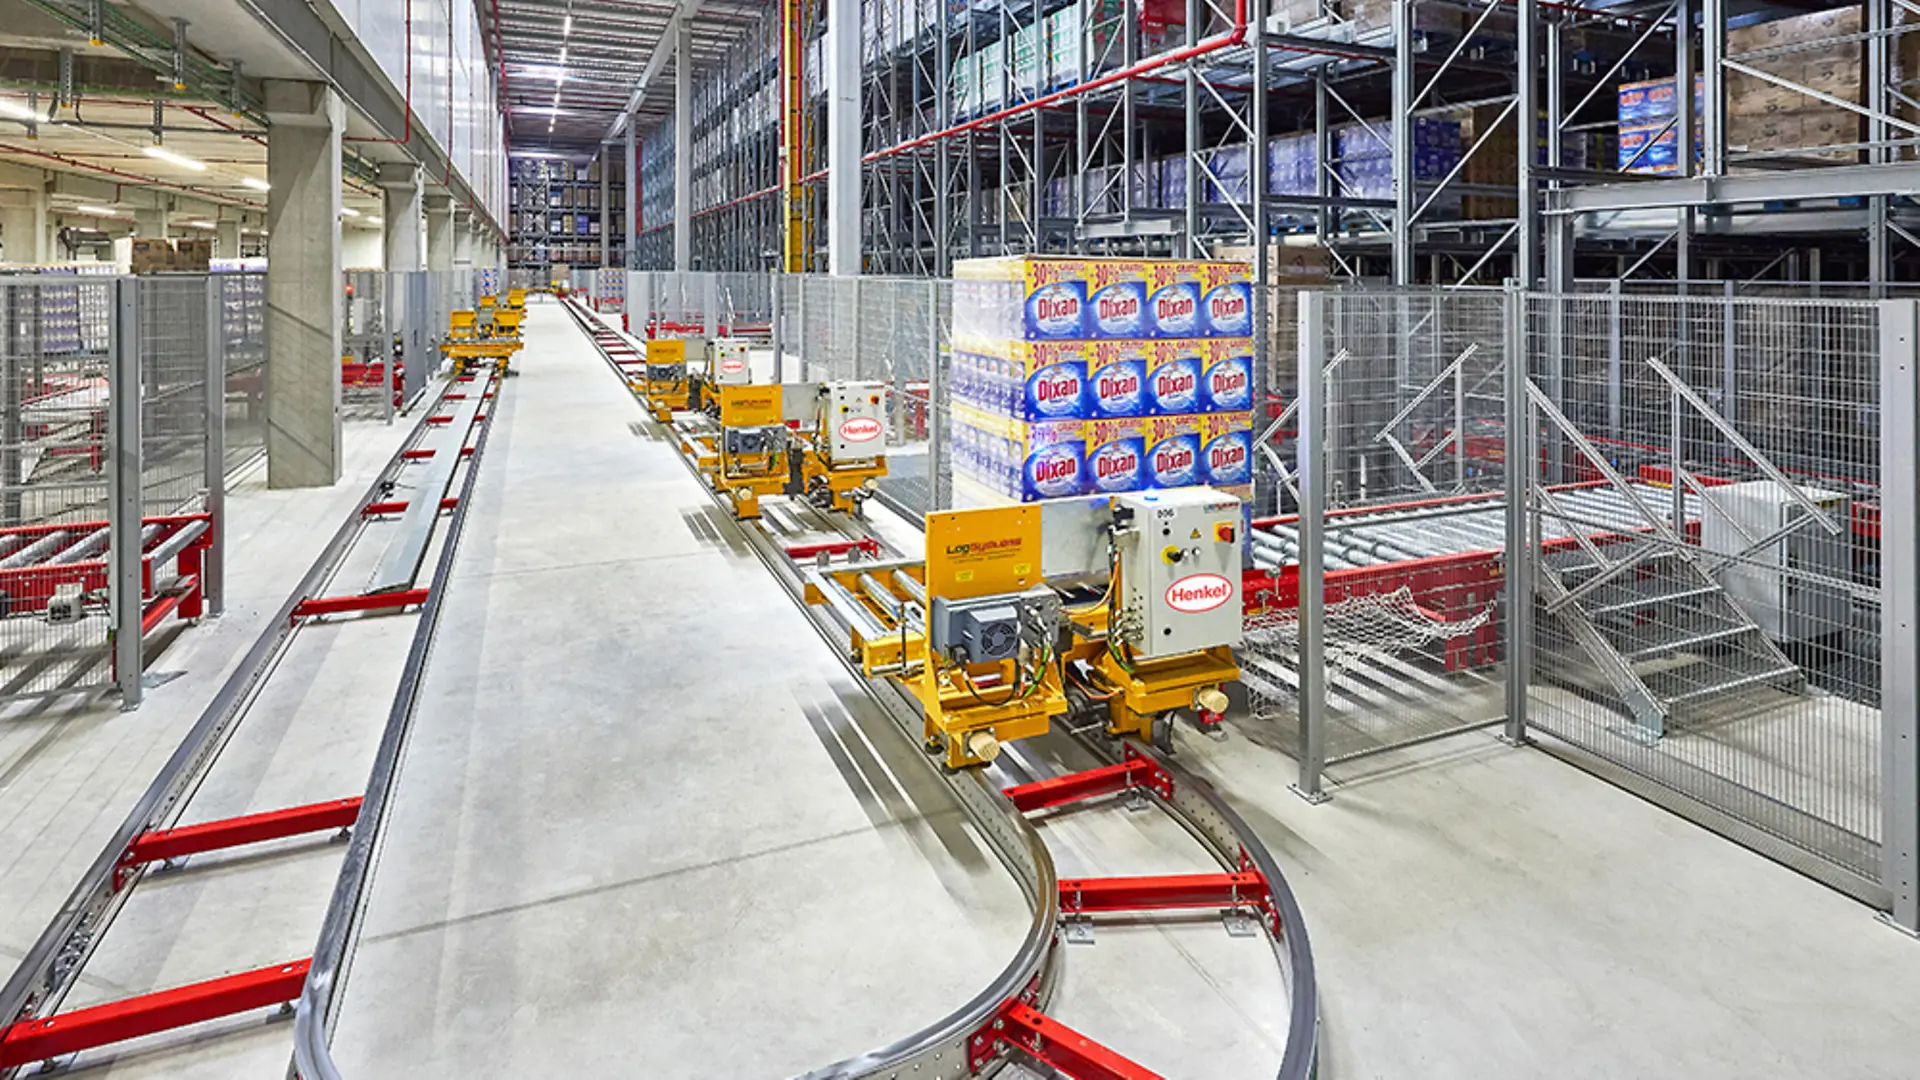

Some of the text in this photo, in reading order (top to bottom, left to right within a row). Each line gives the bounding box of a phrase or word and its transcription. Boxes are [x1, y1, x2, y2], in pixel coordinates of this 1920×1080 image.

[1038, 298, 1078, 320] Dixan
[1100, 298, 1137, 319] Dixan
[1158, 298, 1193, 319] Dixan
[1212, 298, 1244, 318] Dixan
[1038, 378, 1078, 401] Dixan
[1100, 376, 1137, 399] Dixan
[1158, 374, 1193, 397] Dixan
[1213, 372, 1245, 394] Dixan
[843, 423, 877, 435] Henkel
[1098, 454, 1136, 478] Dixan
[1157, 450, 1192, 473] Dixan
[1211, 446, 1244, 469] Dixan
[1036, 458, 1076, 482] Dixan
[1171, 582, 1227, 602] Henkel
